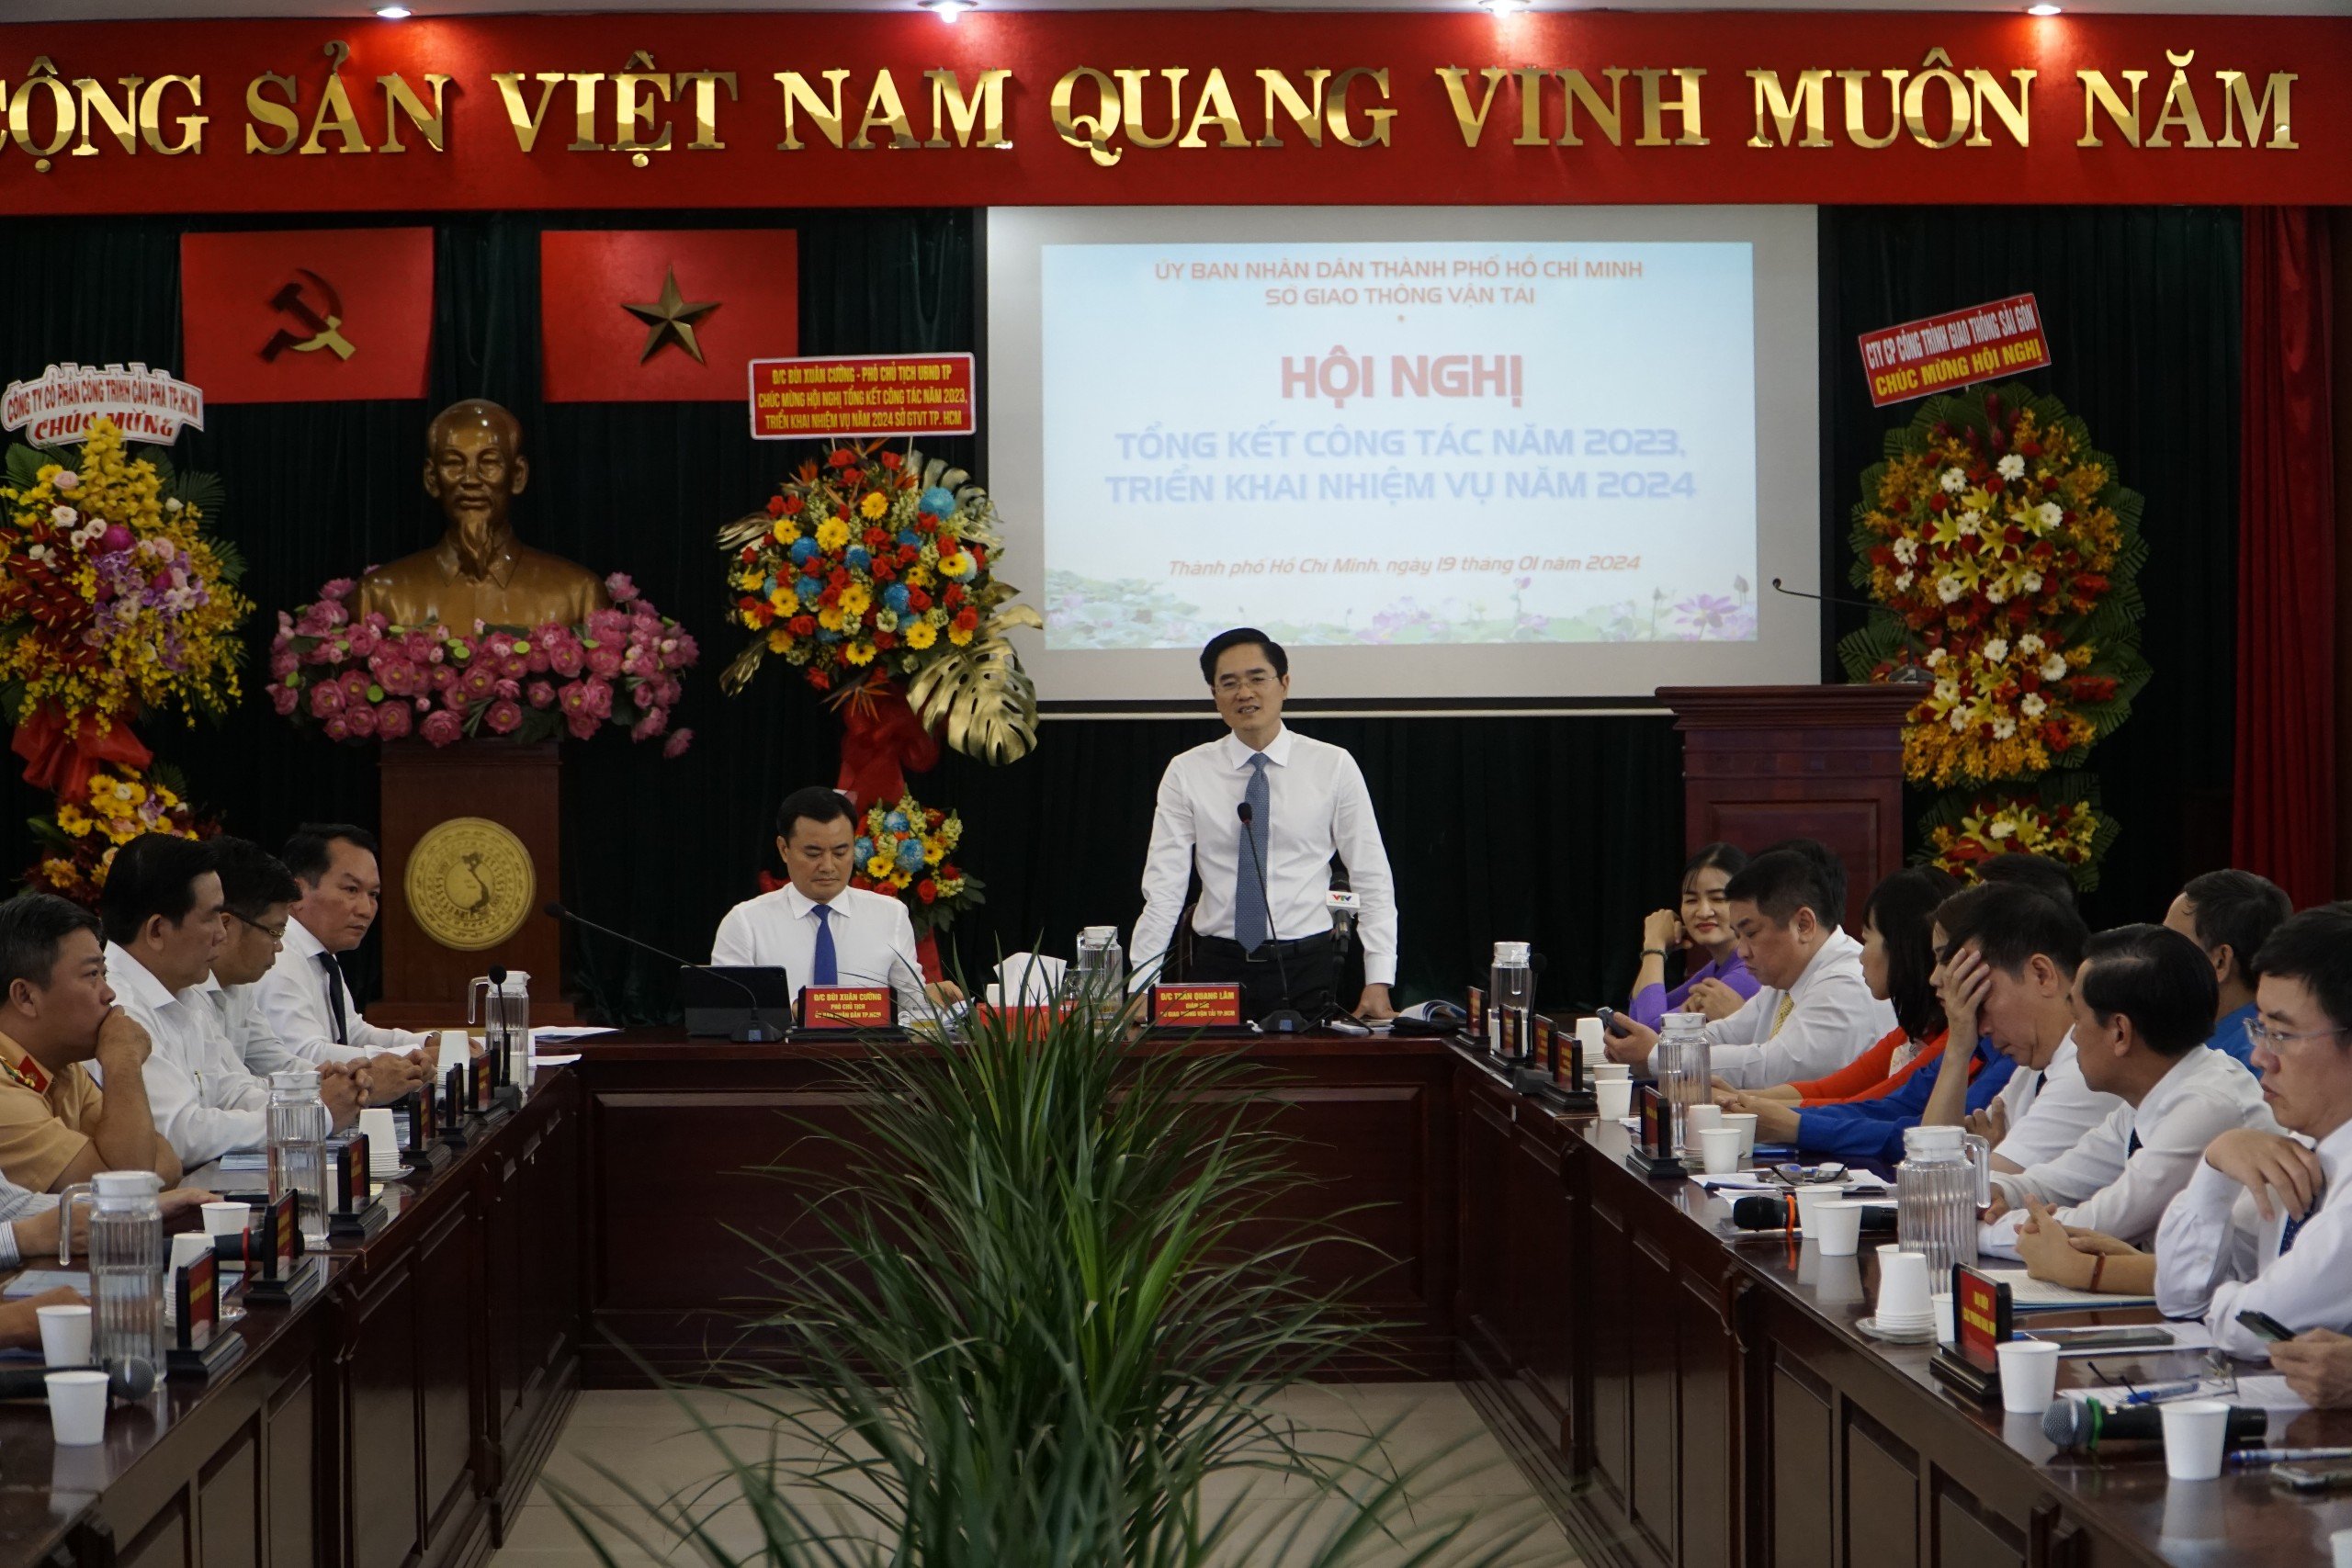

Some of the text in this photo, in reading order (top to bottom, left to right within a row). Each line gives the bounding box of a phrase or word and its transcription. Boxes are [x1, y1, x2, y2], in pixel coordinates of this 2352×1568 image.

[245, 40, 453, 154] SẢN
[491, 50, 738, 168] VIỆT
[774, 68, 1013, 151] NAM
[1049, 66, 1398, 167] QUANG
[1435, 64, 1710, 147] VINH
[1746, 47, 2038, 149] MUÔN
[2076, 49, 2300, 150] NĂM
[1192, 262, 1238, 279] BAN
[1246, 258, 1309, 278] NHÂN
[1317, 258, 1364, 278] DÂN
[1371, 255, 1445, 277] THÀNH
[1453, 254, 1501, 277] PHỐ
[1507, 254, 1537, 277] HỒ
[1544, 256, 1578, 277] CHÍ
[1585, 260, 1643, 277] MINH
[1305, 288, 1358, 305] GIAO
[1364, 283, 1442, 304] THÔNG
[1447, 283, 1494, 308] VẬN
[1865, 299, 2037, 369] CTY CP CÔNG TRÌNH GIAO THÔNG SÀI GÒN
[788, 366, 802, 383] BÙI
[804, 365, 826, 383] XUÂN
[828, 364, 855, 383] CƯỜNG
[862, 363, 878, 382] PHÓ
[880, 361, 897, 381] CHỦ
[898, 365, 916, 384] TỊCH
[918, 365, 941, 381] UBND
[942, 364, 952, 380] TP
[1282, 345, 1522, 408] HỘI NGHỊ
[1875, 338, 2042, 397] CHÚC MỪNG HỘI NGHỊ
[32, 388, 42, 412] TY
[758, 390, 780, 408] CHÚC
[781, 389, 805, 408] MỪNG
[807, 389, 820, 410] HỘI
[822, 390, 842, 409] NGHỊ
[842, 385, 864, 406] TỔNG
[865, 387, 881, 405] KẾT
[883, 387, 905, 405] CÔNG
[906, 387, 922, 404] TÁC
[923, 387, 942, 404] NĂM
[765, 409, 788, 429] TRIỂN
[790, 413, 810, 429] KHAI
[811, 411, 837, 431] NHIỆM
[839, 413, 851, 431] VỤ
[852, 410, 870, 428] NĂM
[872, 412, 894, 427] 2024
[894, 407, 906, 426] SỞ
[907, 411, 928, 426] GTVT
[1115, 421, 1217, 459] TỔNG
[1228, 420, 1295, 457] KẾT
[1305, 423, 1408, 457] CÔNG
[1415, 422, 1483, 457] TÁC
[1493, 423, 1574, 456] NĂM
[1105, 465, 1697, 506] TRIỂN KHAI NHIỆM VỤ NĂM 2024
[1169, 559, 1225, 575] Thành
[1385, 557, 1432, 576] ngày
[1437, 556, 1456, 571] 19
[1461, 556, 1514, 575] tháng
[1586, 555, 1642, 570] 2024
